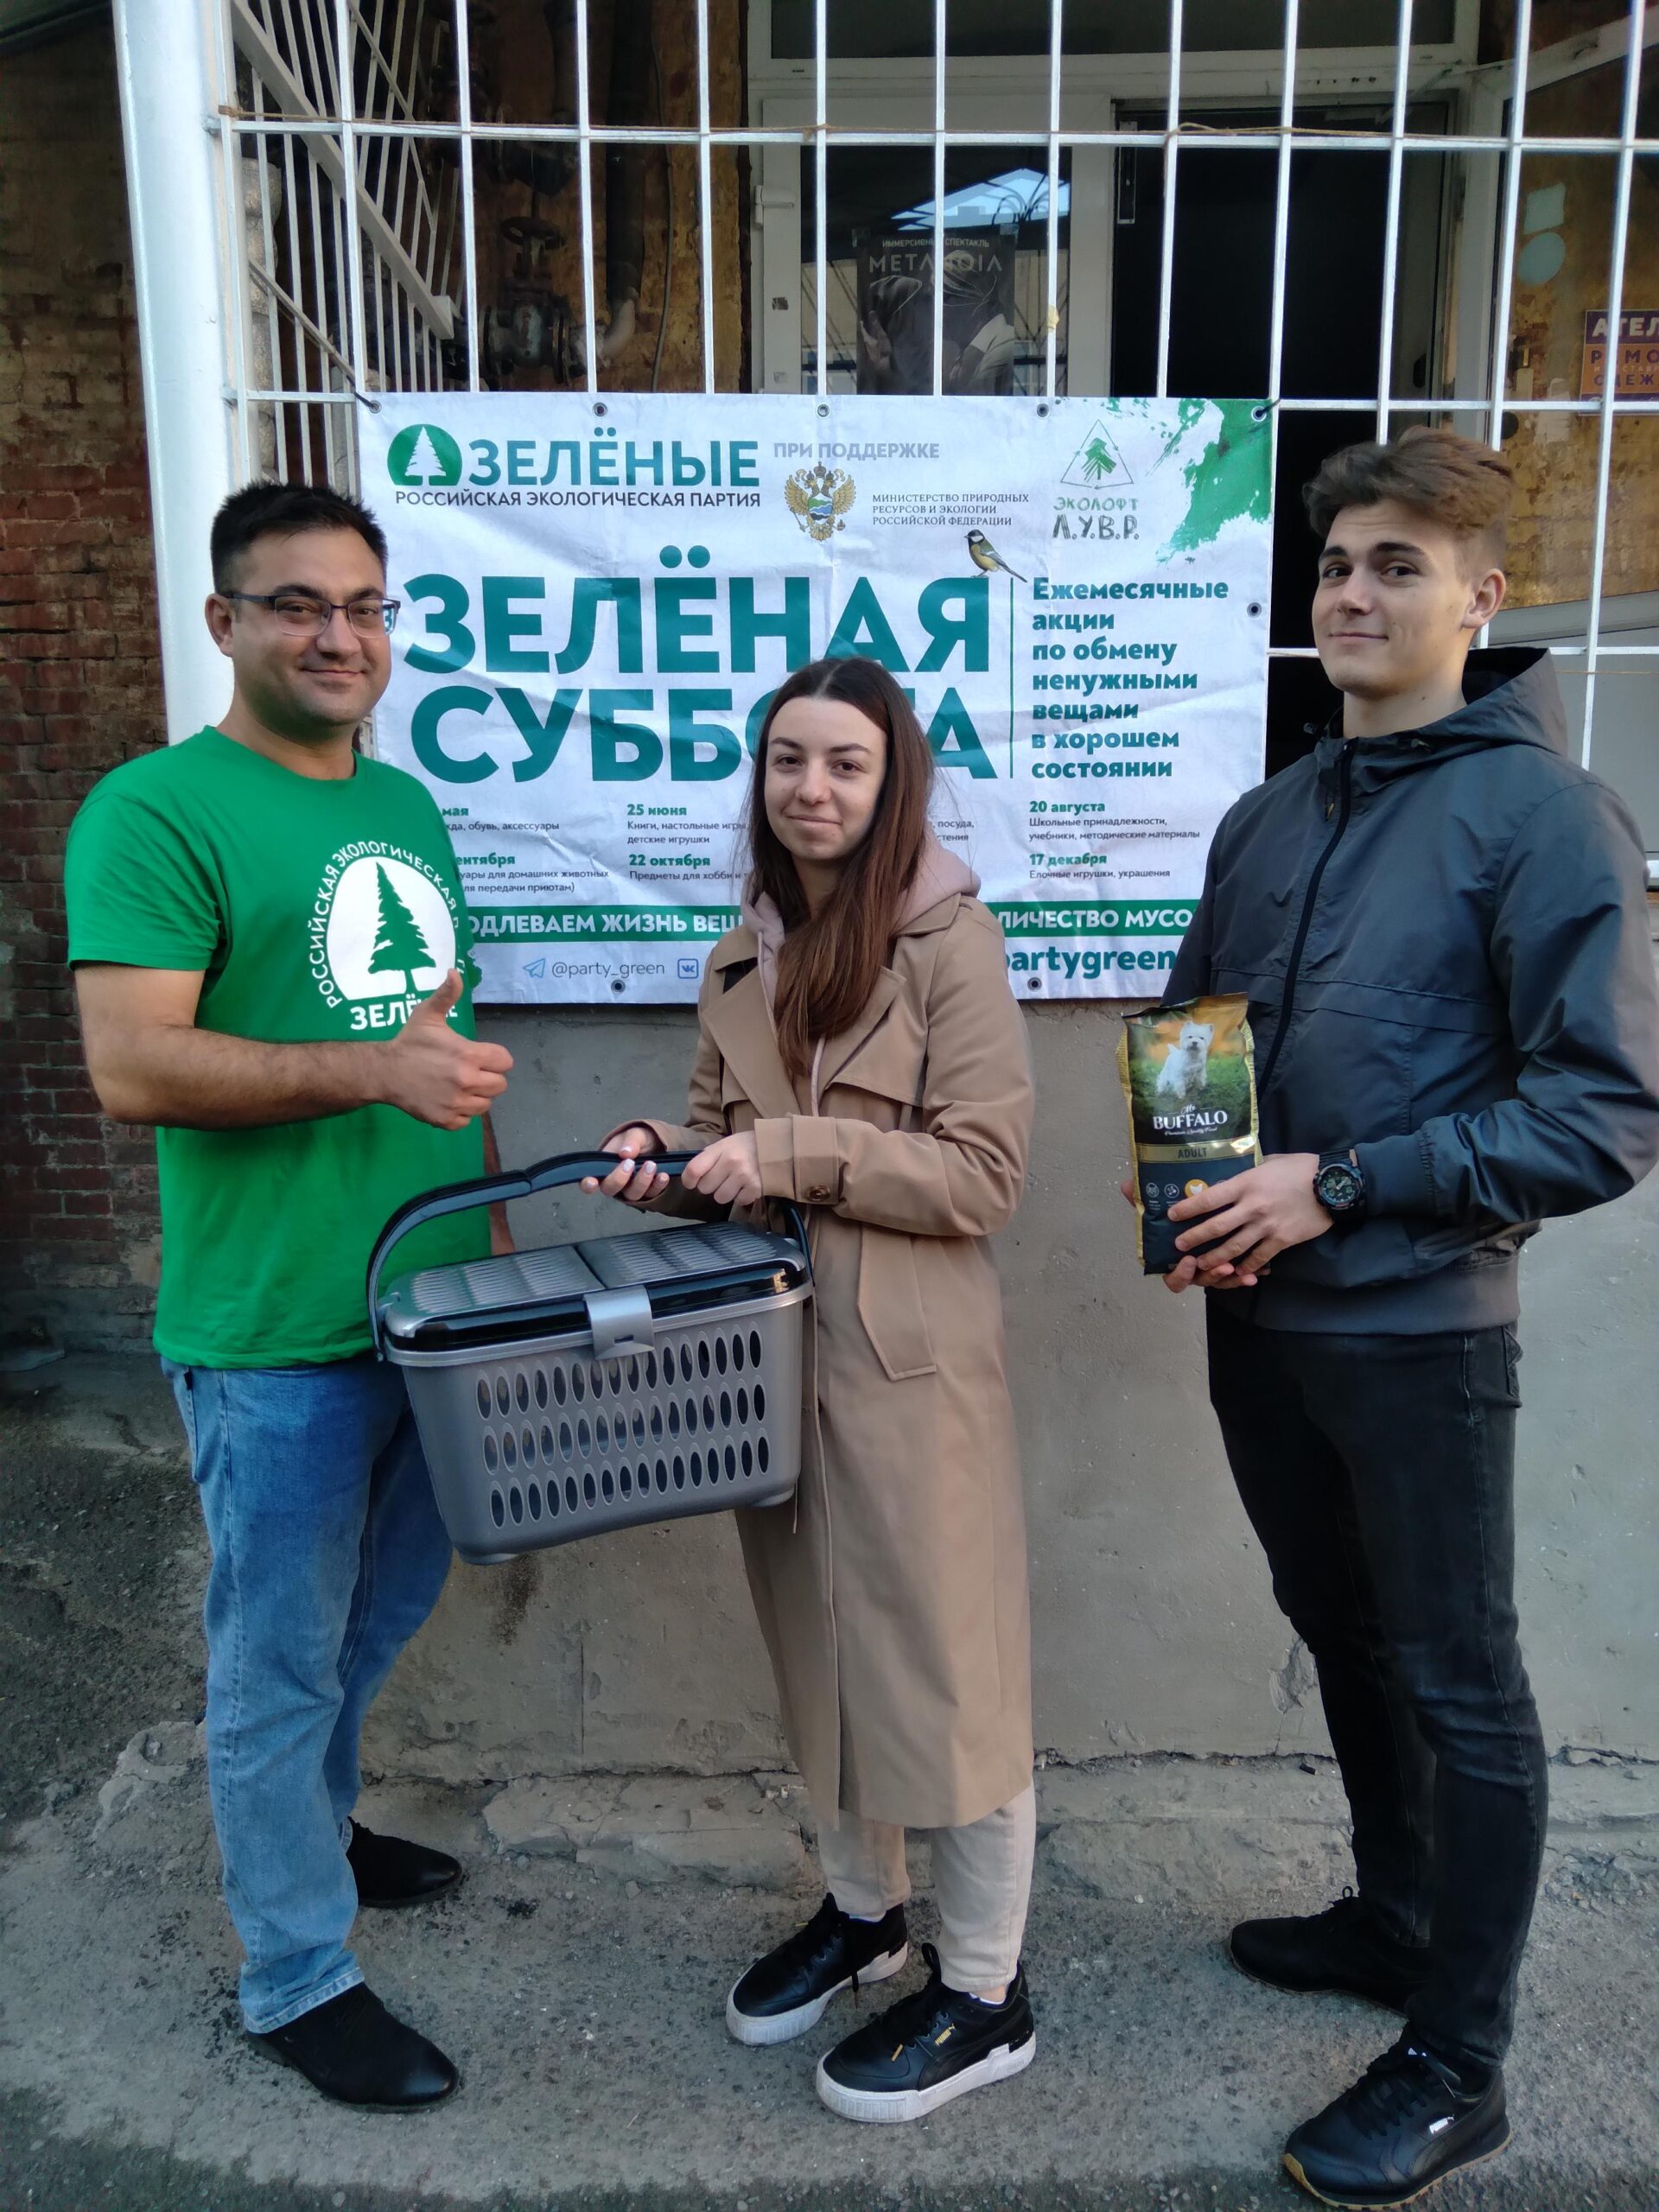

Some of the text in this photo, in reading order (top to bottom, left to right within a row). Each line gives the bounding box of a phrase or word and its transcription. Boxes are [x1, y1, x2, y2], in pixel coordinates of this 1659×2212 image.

[882, 238, 989, 247] ИММЕРСИВН СПЕКТАКЛЬ
[468, 427, 760, 486] ЗЕЛЁНЫЕ
[774, 442, 940, 461] ПРИ ПОДДЕРЖКЕ
[396, 488, 760, 507] РОССИЙСКАЯ ЭКОЛОГИЧЕСКАЯ ПАРТИЯ
[873, 493, 1029, 504] МИНИСТЕРСТВО ПРИРОДНЫХ
[1052, 497, 1139, 512] ЭКОЛОФТ
[873, 505, 997, 514] РЕСУРСОВ И ЭКОЛОГИИ
[873, 515, 1013, 526] РОССИЙСКОЙ ФЕДЕРАЦИИ
[1052, 514, 1140, 540] Л.У.В.Р.
[1033, 577, 1229, 601] Ежемесячные
[404, 544, 989, 674] ЗЕЛЁНАЯ
[1032, 613, 1115, 632] акции
[1033, 635, 1178, 666] по обмену
[1033, 673, 1198, 697] ненужными
[1032, 703, 1139, 723] вещами
[410, 685, 999, 784] СУББА
[1032, 732, 1179, 755] в хорошем
[1031, 761, 1173, 779] состоянии
[442, 807, 469, 817] мая
[627, 804, 687, 817] 25 июня
[1029, 800, 1106, 816] 20 августа
[468, 822, 500, 831] обувь,
[502, 823, 560, 831] аксессуары
[627, 821, 660, 830] Книги,
[938, 820, 975, 830] посуда,
[1029, 817, 1167, 828] Школьные принадлежности,
[627, 836, 710, 846] детские игрушки
[1028, 830, 1200, 842] учебники, методические материалы
[455, 852, 516, 868] ентября
[629, 853, 711, 869] 22 октября
[1029, 852, 1107, 868] 17 декабря
[458, 869, 609, 881] уары для домашних животных
[629, 871, 681, 881] Предметы
[683, 873, 701, 881] для
[702, 870, 733, 880] хобби
[1029, 869, 1171, 880] Елочные игрушки, украшения
[478, 884, 525, 893] передачи
[527, 882, 575, 893] приютам)
[307, 863, 343, 1009] РОССИЙСКАЯ
[332, 840, 457, 911] ЭКОЛОГИЧЕСКАЯ
[467, 914, 596, 938] ОДЛЕВАЕМ
[601, 913, 688, 932] ЖИЗНЬ
[998, 909, 1193, 928] ЛИЧЕСТВО МУСО
[552, 961, 665, 979] @party_green
[1153, 1109, 1228, 1129] BUFFALO
[1178, 1147, 1207, 1159] ADULT
